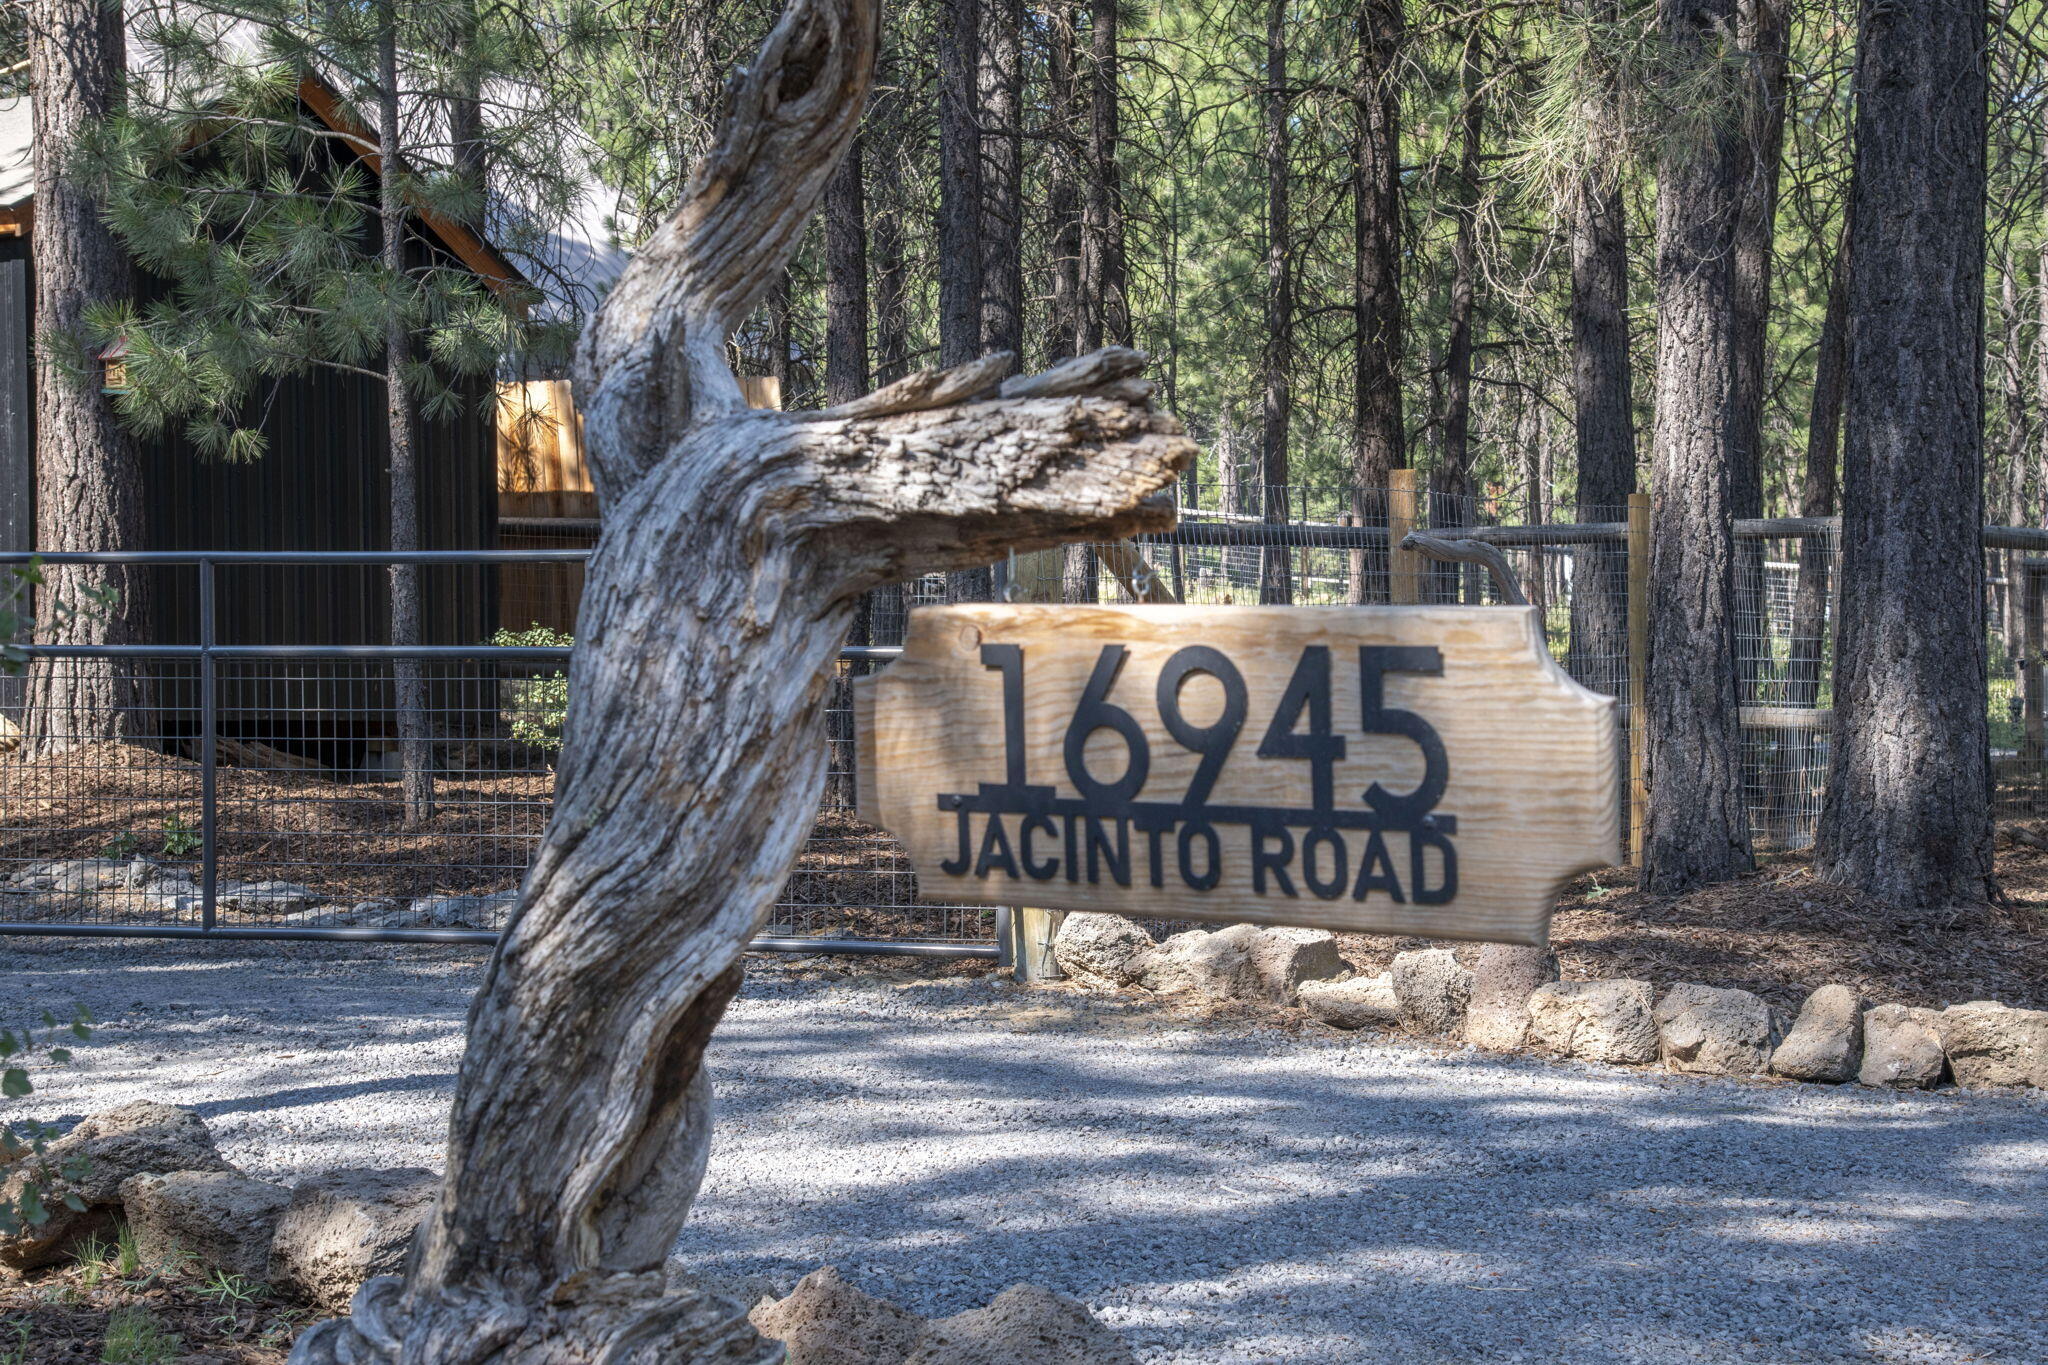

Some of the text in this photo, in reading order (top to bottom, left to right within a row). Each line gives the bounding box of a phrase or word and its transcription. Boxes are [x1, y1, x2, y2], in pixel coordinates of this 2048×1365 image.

[979, 643, 1450, 826] 16945
[940, 808, 1459, 906] JACINTO ROAD
